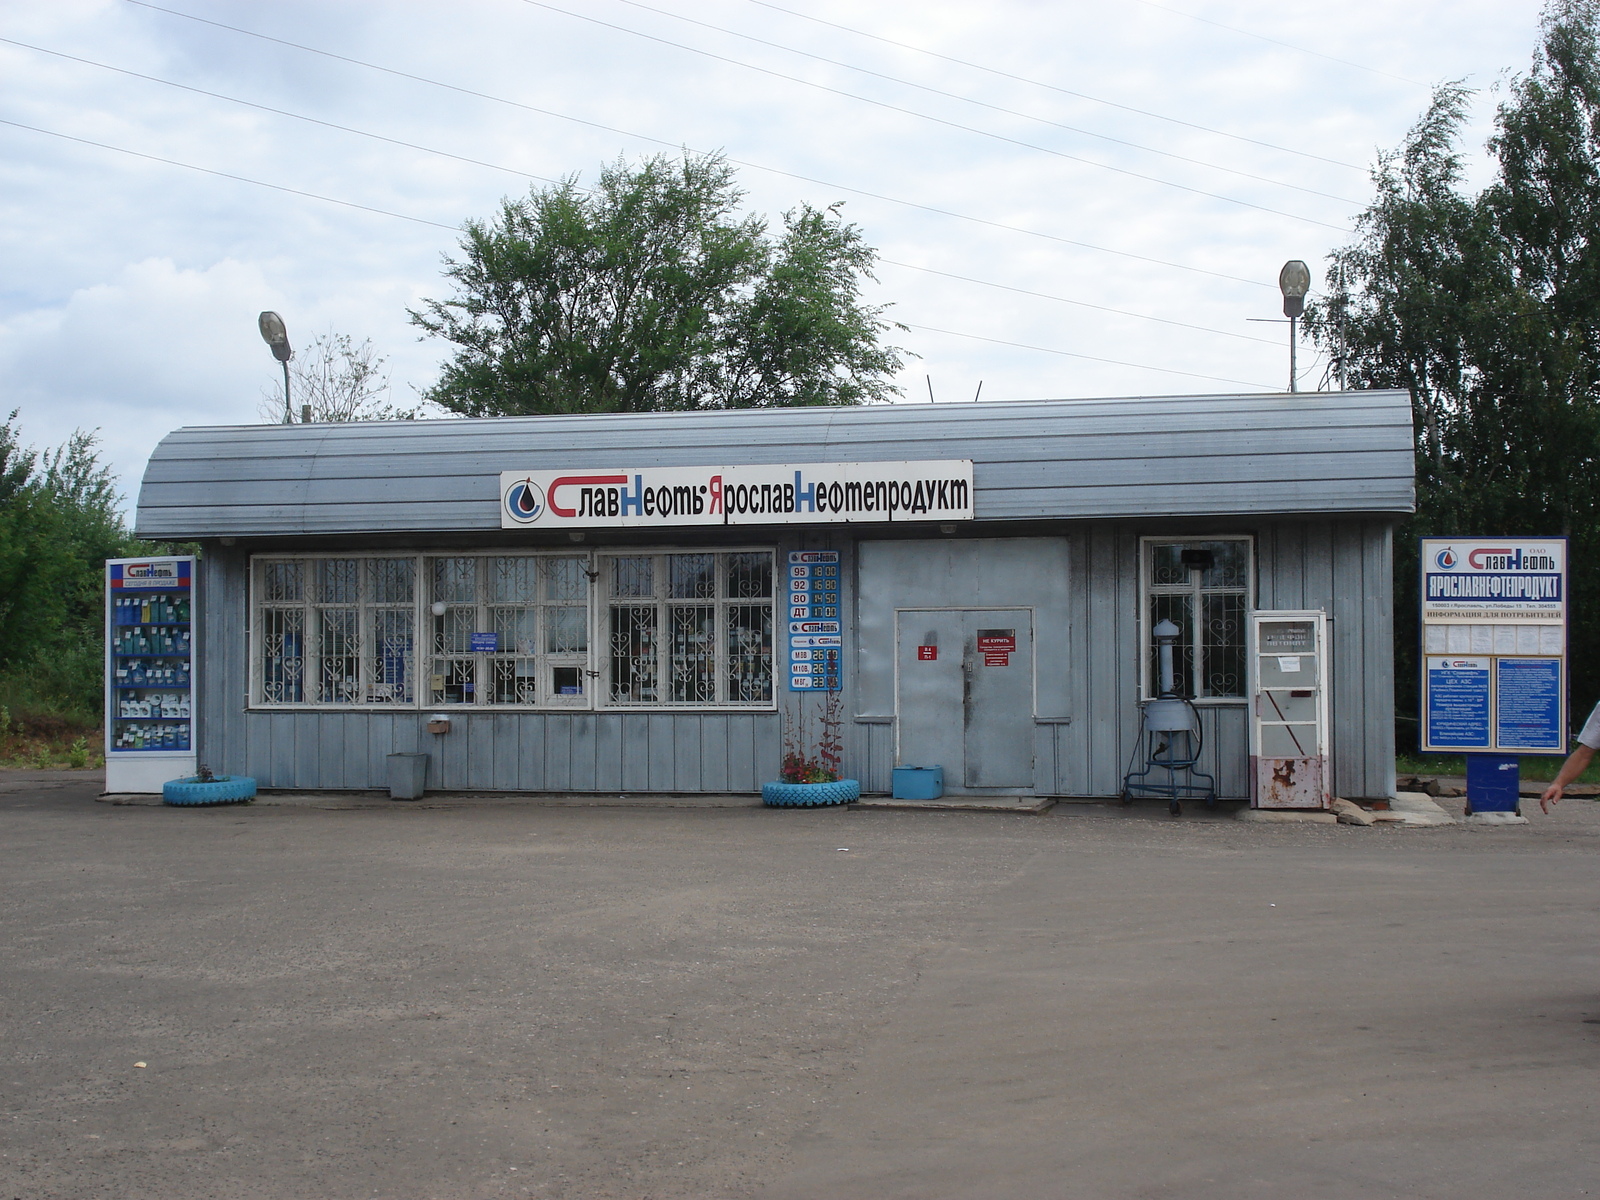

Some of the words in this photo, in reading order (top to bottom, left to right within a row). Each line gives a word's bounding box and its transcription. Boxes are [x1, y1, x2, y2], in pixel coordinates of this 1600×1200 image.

[794, 567, 805, 576] 95
[794, 580, 805, 589] 92
[1430, 576, 1558, 600] ЯРОСЛАВНЕФТЕПРОДУКТ
[794, 594, 806, 603] 80
[794, 608, 806, 617] ДТ
